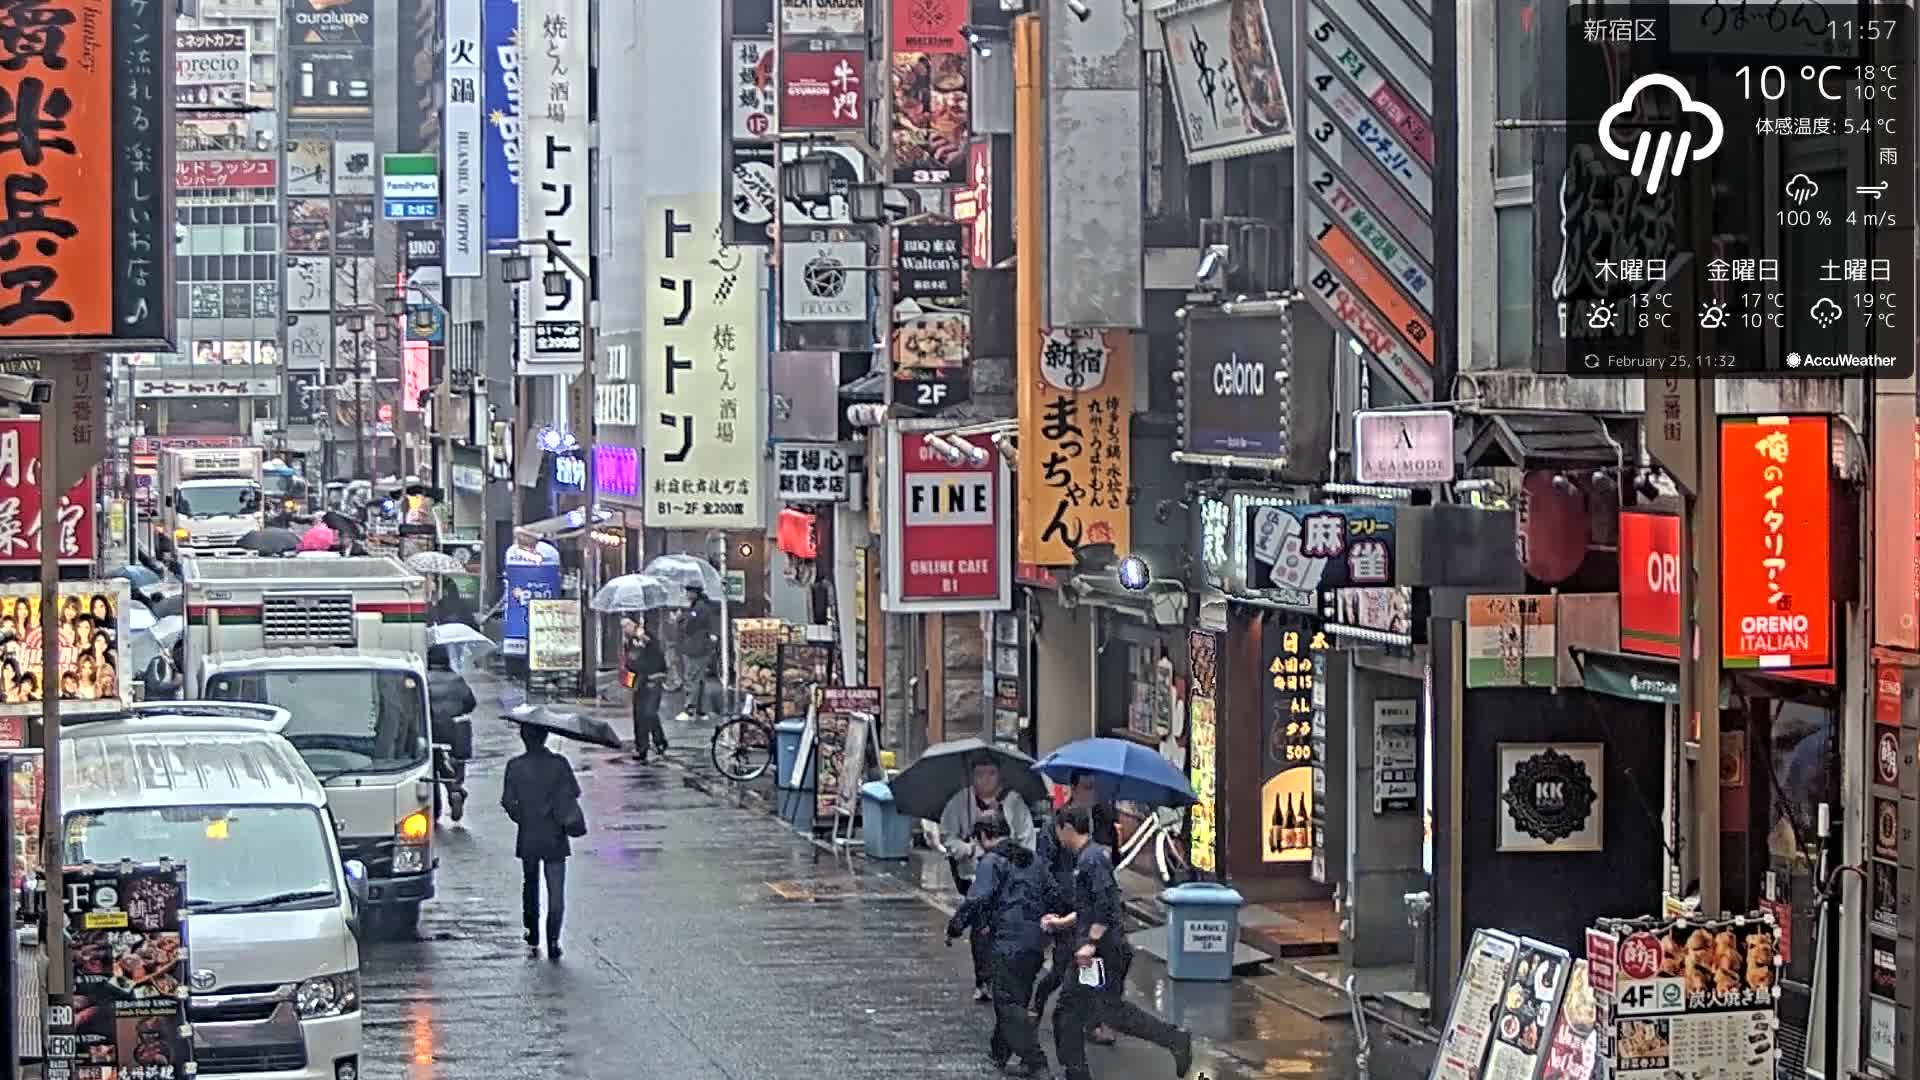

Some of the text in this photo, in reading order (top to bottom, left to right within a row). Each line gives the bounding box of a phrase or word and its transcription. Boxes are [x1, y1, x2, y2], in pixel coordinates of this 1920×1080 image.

[296, 12, 369, 25] auralume
[1314, 22, 1335, 42] 5
[450, 39, 475, 104] 火鍋
[543, 15, 570, 123] 焼とん酒場
[831, 58, 859, 119] 牛門
[1315, 74, 1335, 92] 4
[1315, 122, 1335, 143] 3
[912, 169, 950, 183] 3F
[1313, 172, 1334, 193] 2
[386, 182, 436, 192] FamilyMart
[408, 204, 436, 216] たばこ
[457, 204, 470, 255] HOTPOT
[1317, 222, 1333, 241] 1
[901, 256, 960, 270] Walton's
[1312, 268, 1340, 299] B1
[660, 208, 693, 462] トントン
[712, 324, 738, 443] 焼とん酒場
[1214, 352, 1264, 396] celona
[917, 384, 947, 405] 2F
[1041, 396, 1086, 549] まっちゃん
[1403, 460, 1445, 472] MODE
[912, 485, 987, 513] FINE
[1350, 521, 1389, 534] フリー
[1756, 431, 1788, 604] 俺のイタリアン
[910, 560, 989, 574] ONLINE CAFE
[942, 579, 958, 593] B1
[1741, 615, 1808, 634] ORENO
[1741, 635, 1808, 651] ITALIAN
[1286, 745, 1311, 760] 500
[1536, 782, 1564, 798] KK
[1621, 985, 1654, 1007] 4F
[1688, 987, 1770, 1009] 炭火焼き鳥
